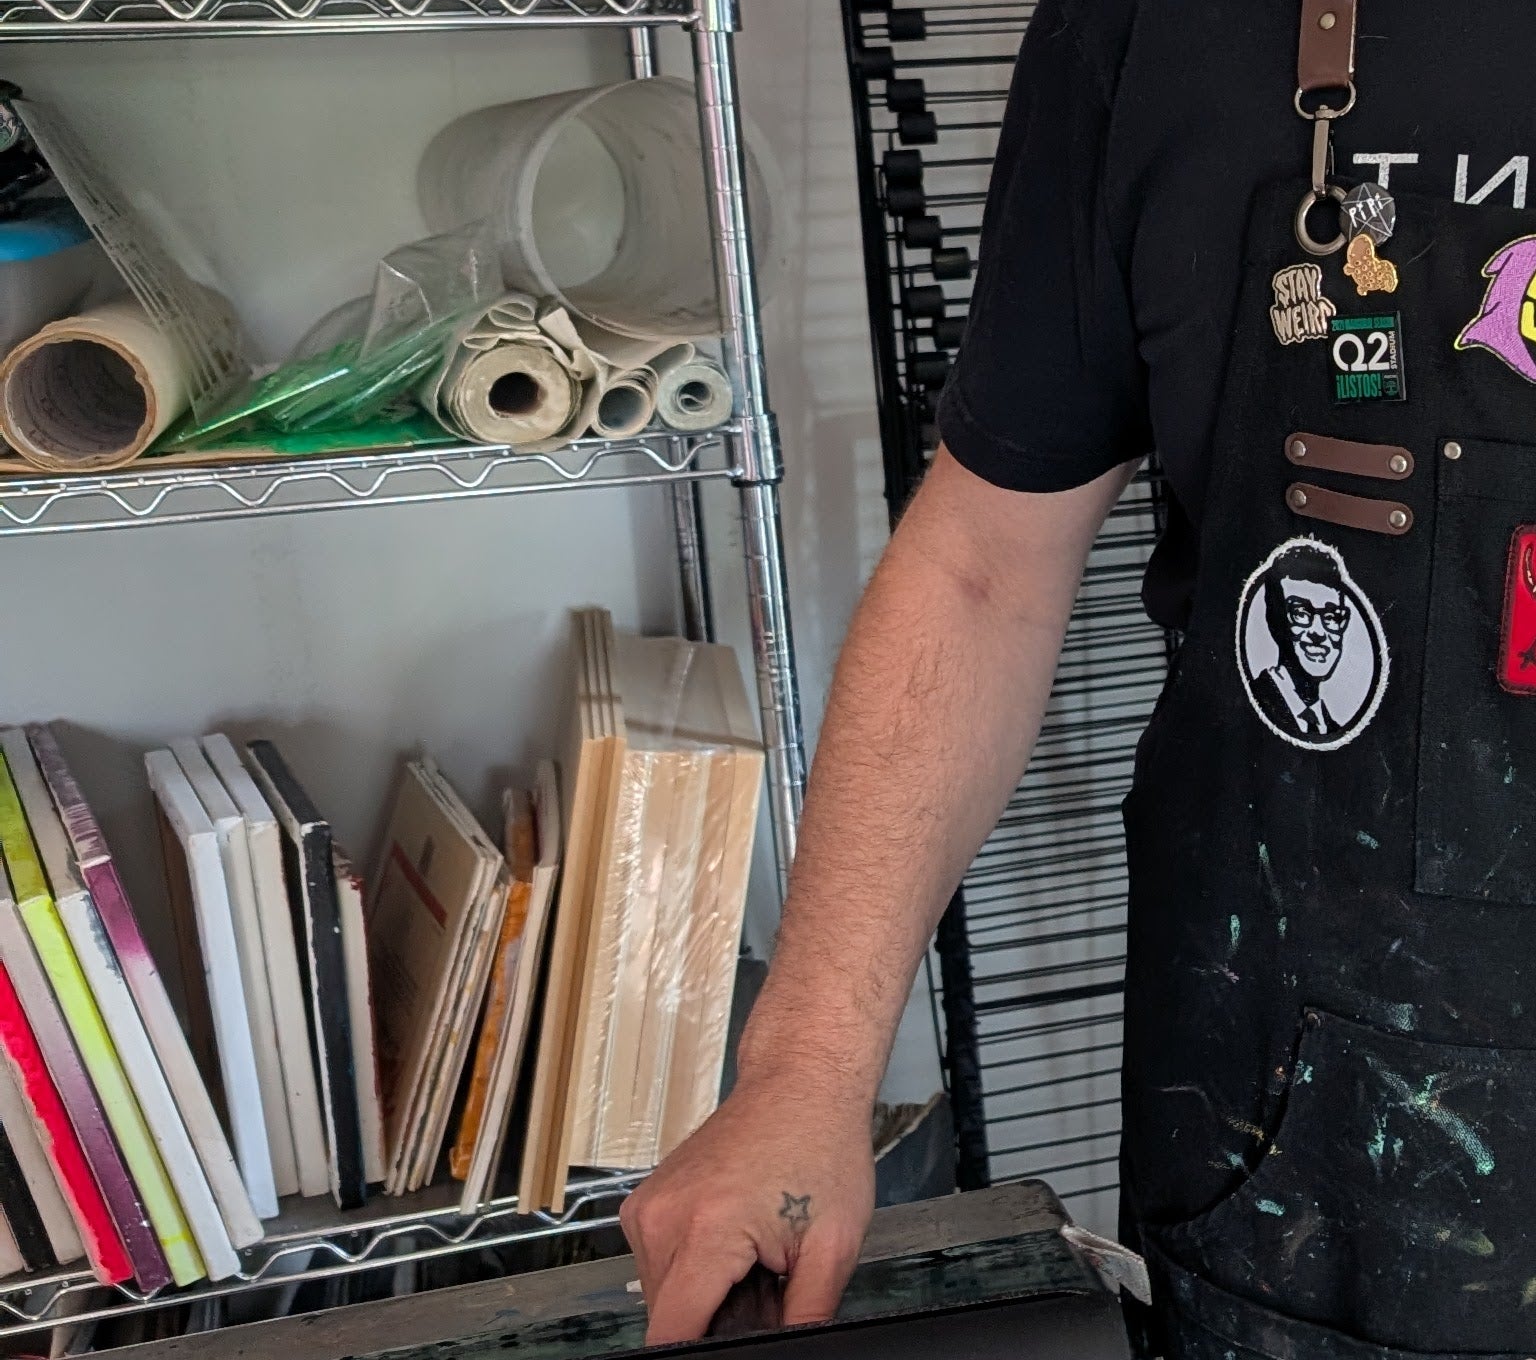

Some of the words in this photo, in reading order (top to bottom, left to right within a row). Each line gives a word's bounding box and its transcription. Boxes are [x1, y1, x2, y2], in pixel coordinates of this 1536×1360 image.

[1276, 266, 1319, 307] STAY
[1333, 331, 1390, 372] Q2
[1388, 330, 1398, 370] STADIUM
